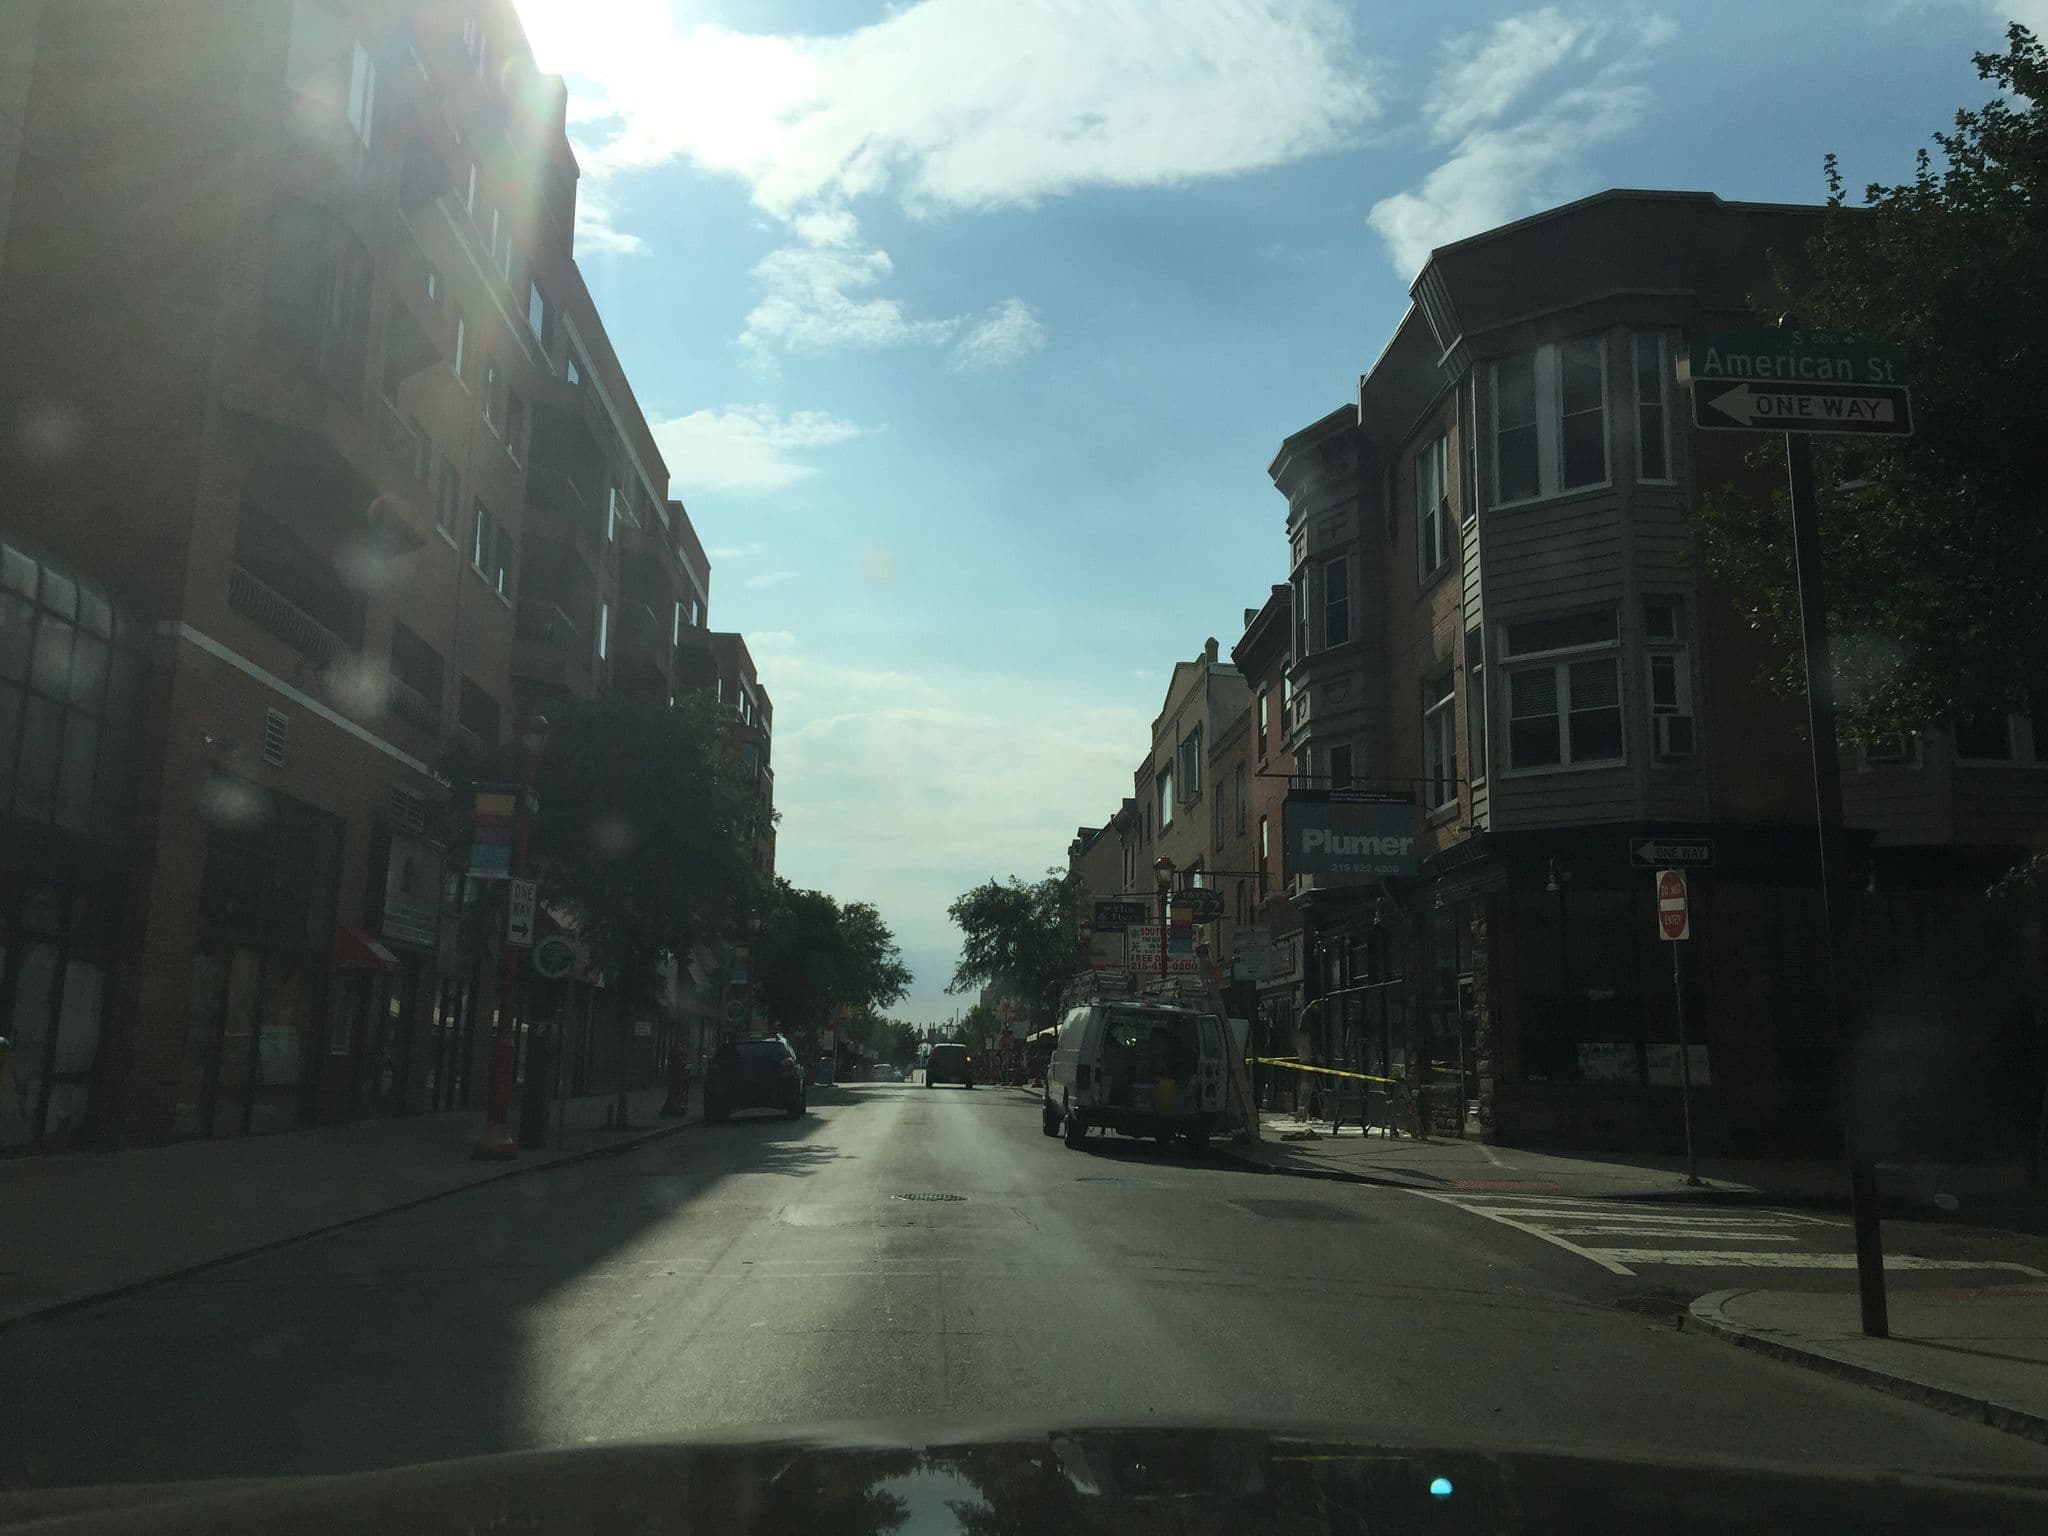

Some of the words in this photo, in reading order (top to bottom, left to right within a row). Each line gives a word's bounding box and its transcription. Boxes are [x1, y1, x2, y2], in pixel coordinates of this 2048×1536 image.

[1704, 347, 1853, 380] American
[1868, 358, 1896, 382] St
[1756, 396, 1812, 416] ONE
[1823, 399, 1880, 419] WAY
[1303, 828, 1414, 856] Plumer
[1657, 847, 1678, 858] ONE
[1682, 848, 1705, 859] WAY
[515, 883, 534, 901] ONE
[514, 903, 531, 918] WAY
[1140, 928, 1165, 936] SOUT
[1131, 954, 1155, 962] FREE
